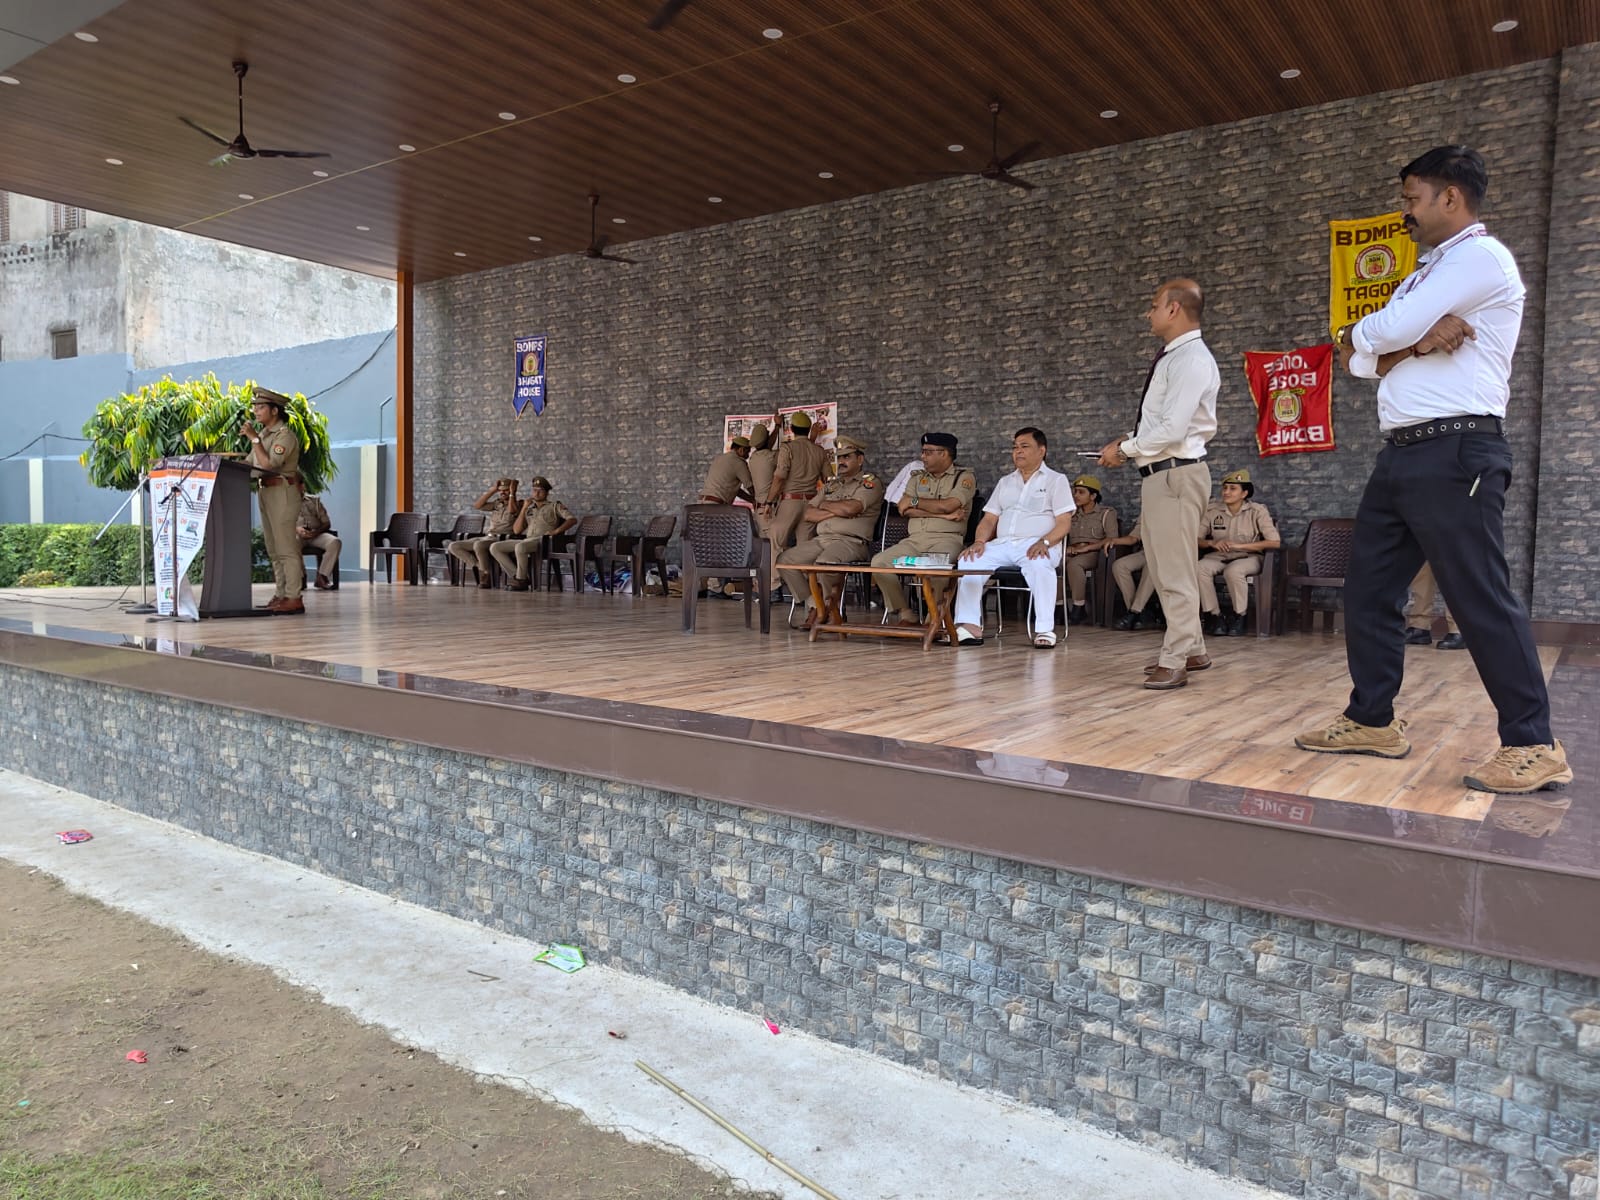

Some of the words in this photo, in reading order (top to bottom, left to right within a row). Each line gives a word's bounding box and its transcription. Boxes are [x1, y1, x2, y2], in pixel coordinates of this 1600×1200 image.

[1335, 222, 1409, 246] BDMPS
[1343, 279, 1405, 301] TAGOR
[1347, 302, 1387, 320] HOU
[1263, 355, 1308, 377] OUSE
[1268, 371, 1317, 391] BOSE
[1267, 425, 1325, 446] BDMP
